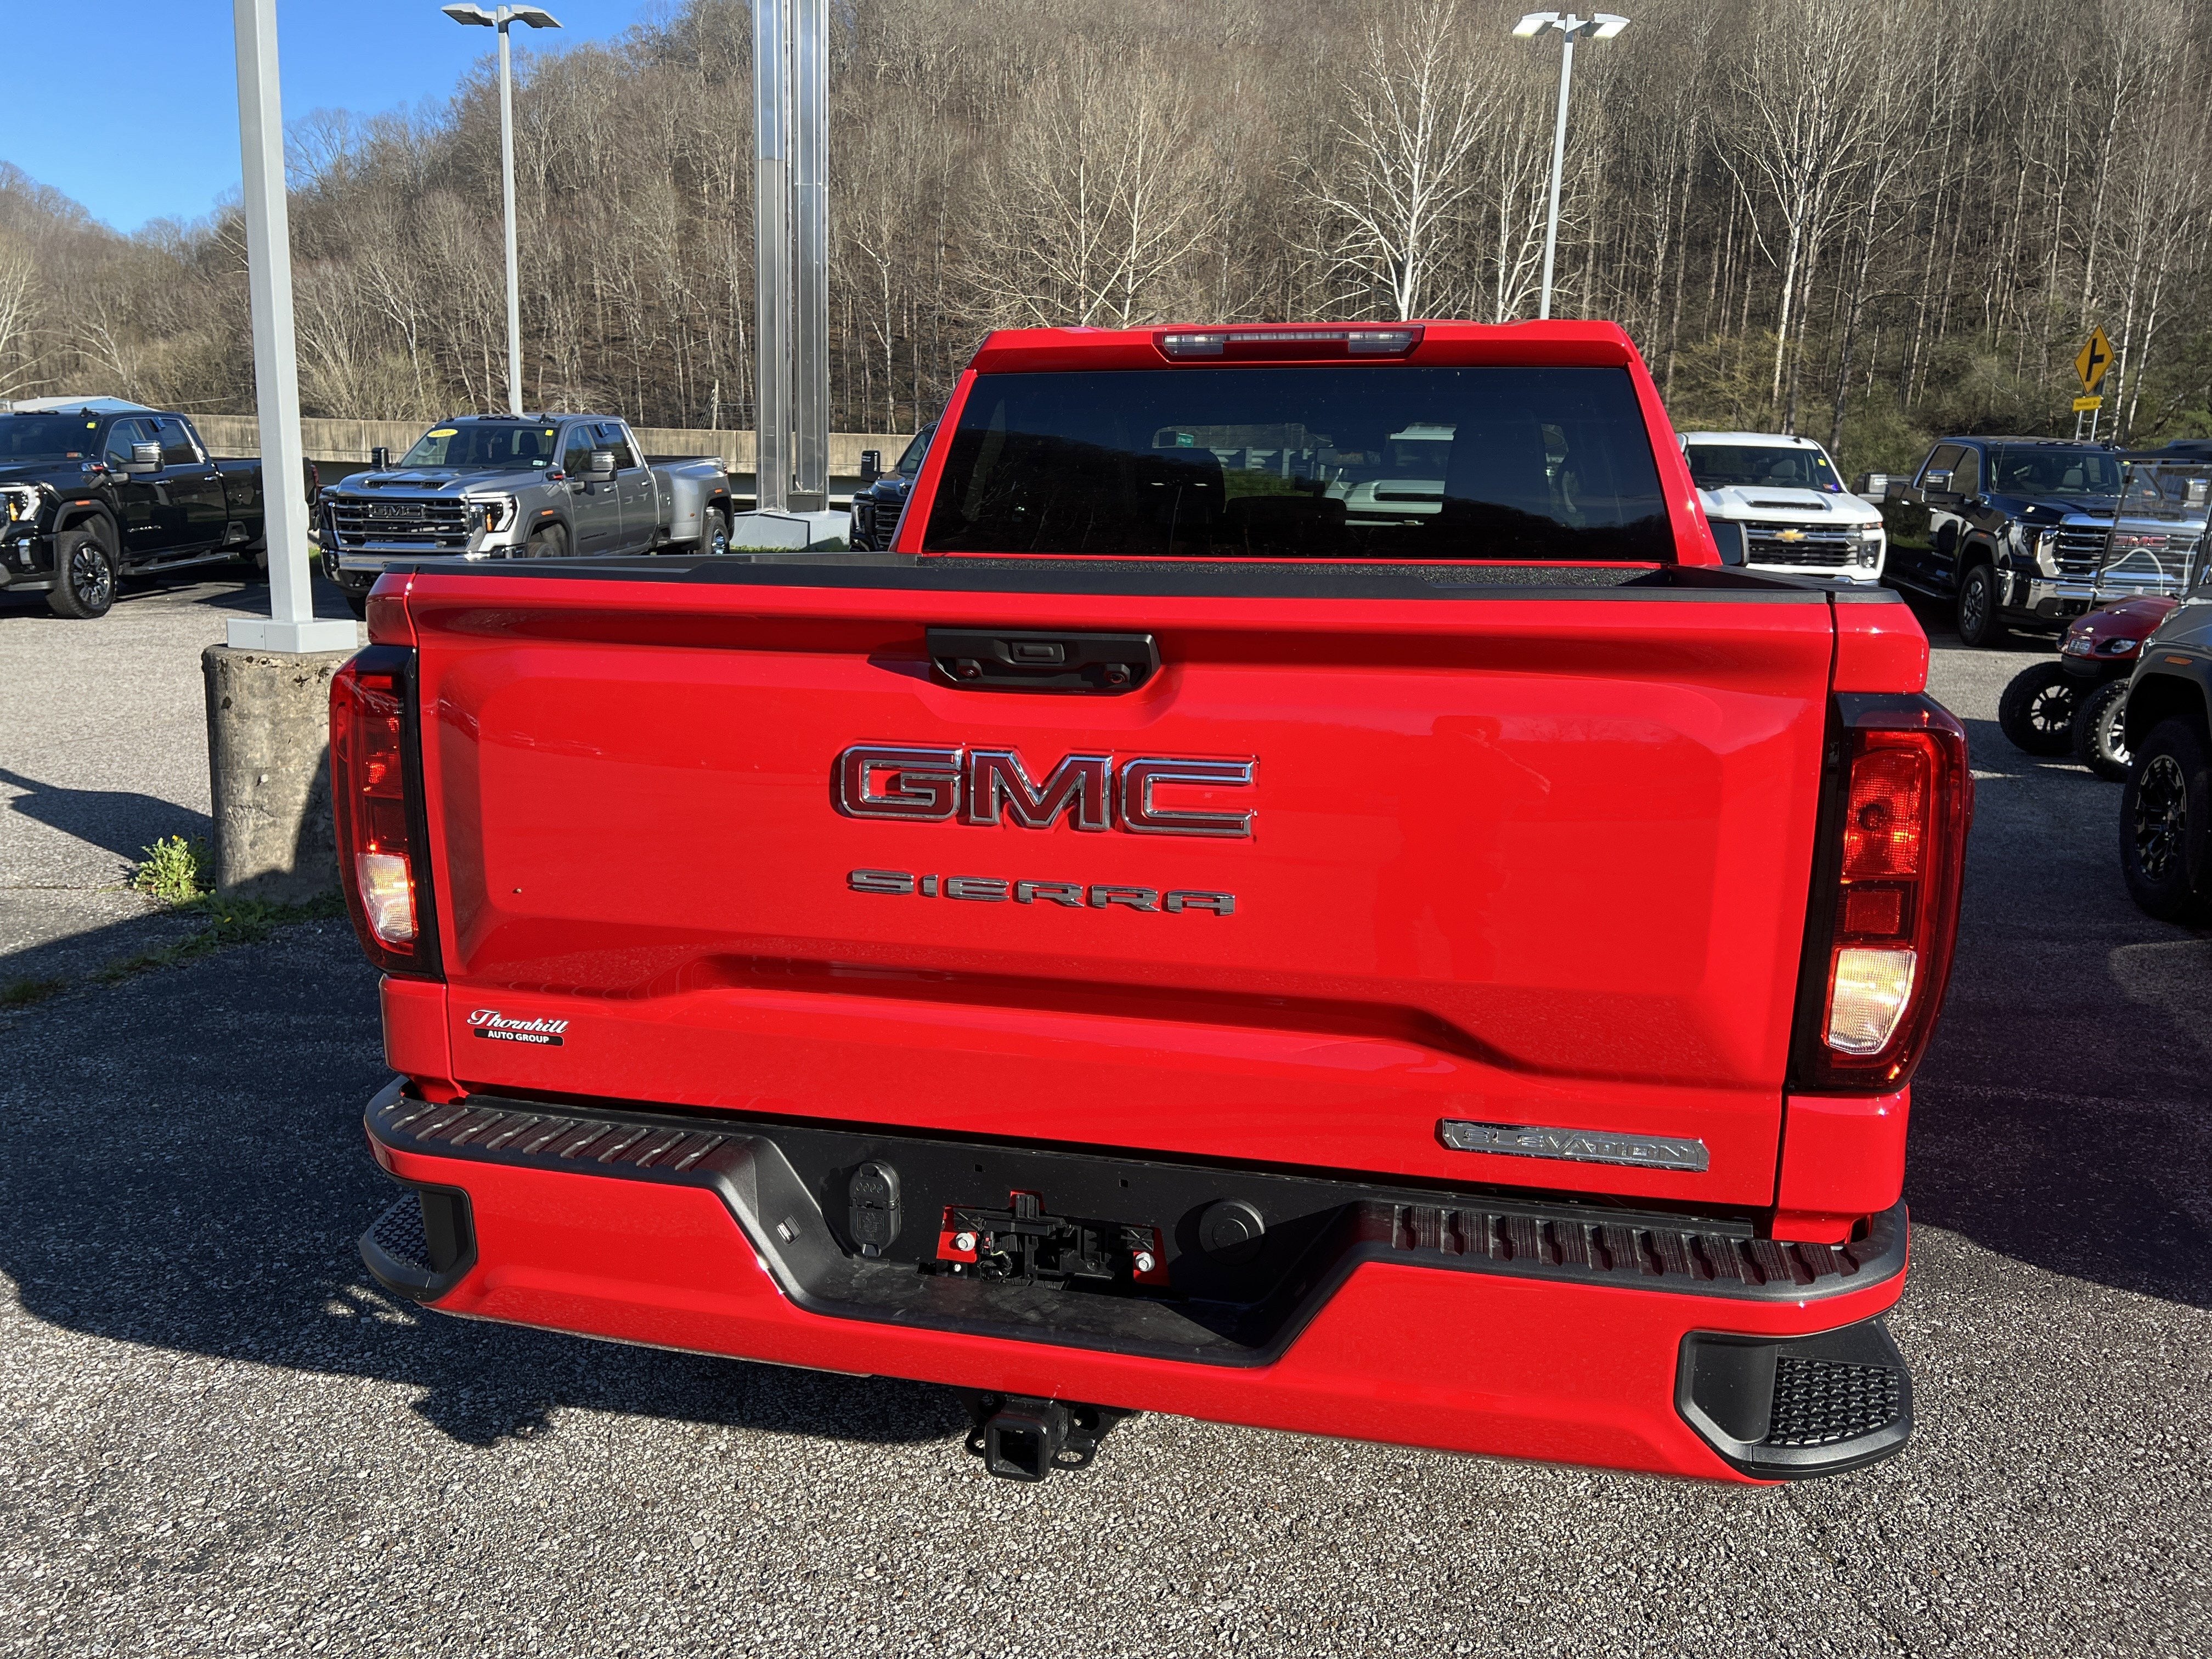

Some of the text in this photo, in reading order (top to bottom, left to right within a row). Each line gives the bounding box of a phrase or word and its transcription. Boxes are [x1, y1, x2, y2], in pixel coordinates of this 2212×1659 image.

[840, 744, 1255, 838] GMC
[850, 868, 1235, 916] SIERRA
[466, 1009, 569, 1034] Thornhill
[487, 1030, 550, 1043] AUTO GROUP
[1463, 1128, 1689, 1162] ELEVATION
